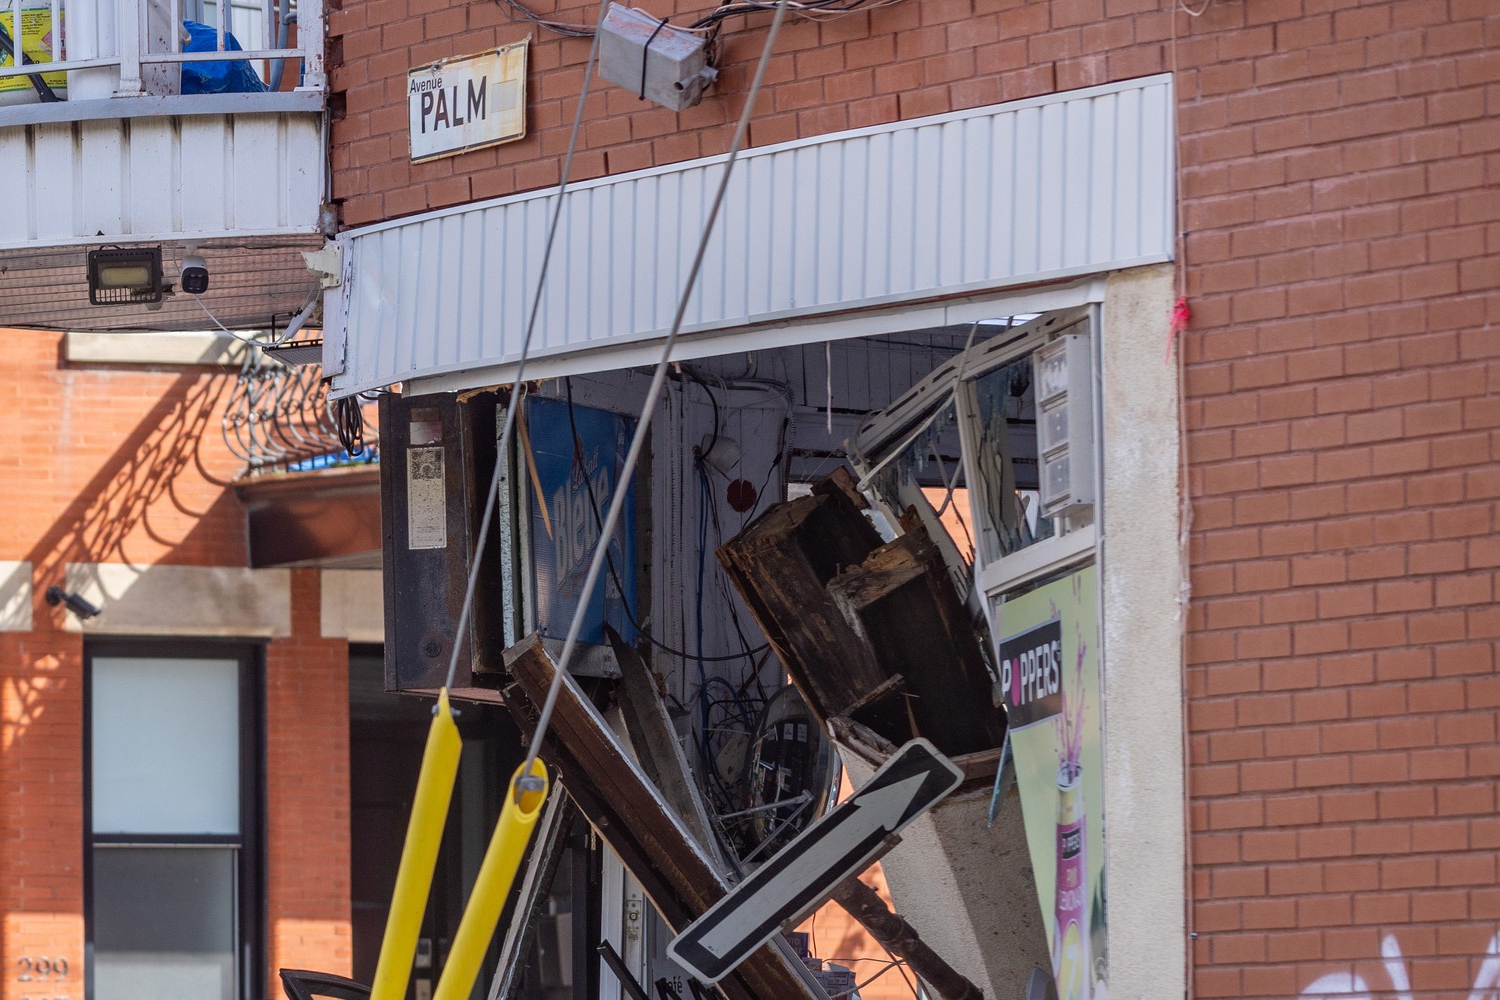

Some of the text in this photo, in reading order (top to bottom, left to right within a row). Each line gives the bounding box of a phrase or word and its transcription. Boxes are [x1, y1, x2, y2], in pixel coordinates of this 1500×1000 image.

[409, 77, 443, 94] Avenue
[421, 75, 487, 134] PALM
[17, 957, 68, 982] 299
